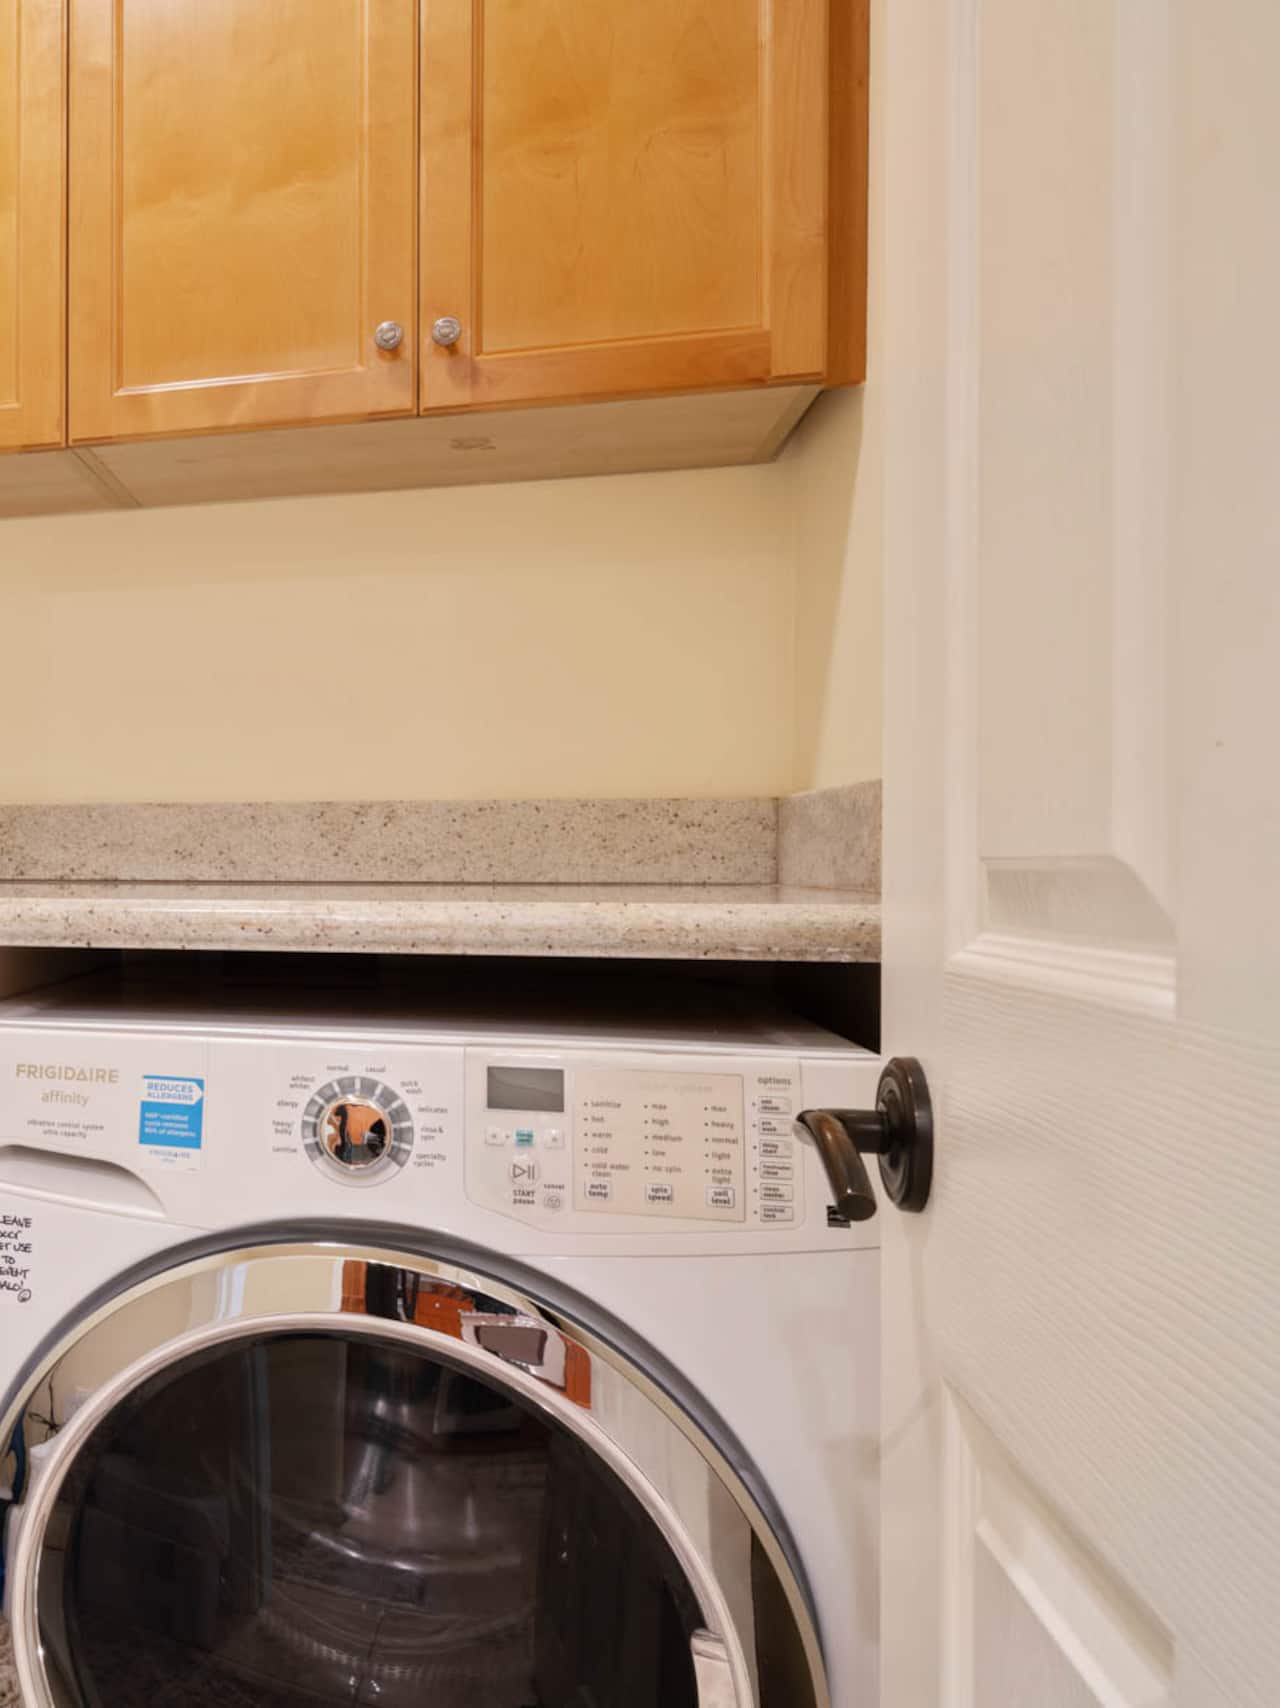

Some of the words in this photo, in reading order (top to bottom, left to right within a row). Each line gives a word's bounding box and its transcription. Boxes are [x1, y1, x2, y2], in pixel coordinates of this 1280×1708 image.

[15, 1063, 119, 1084] FRIGIDAIRE
[758, 1077, 792, 1085] options
[147, 1082, 194, 1093] REDUCES
[41, 1089, 89, 1107] affinity
[711, 1137, 738, 1145] normal
[513, 1189, 535, 1197] START
[588, 1190, 609, 1199] temp
[648, 1193, 672, 1202] speed
[711, 1196, 731, 1205] level
[13, 1242, 32, 1253] USE
[1, 1255, 16, 1264] TO
